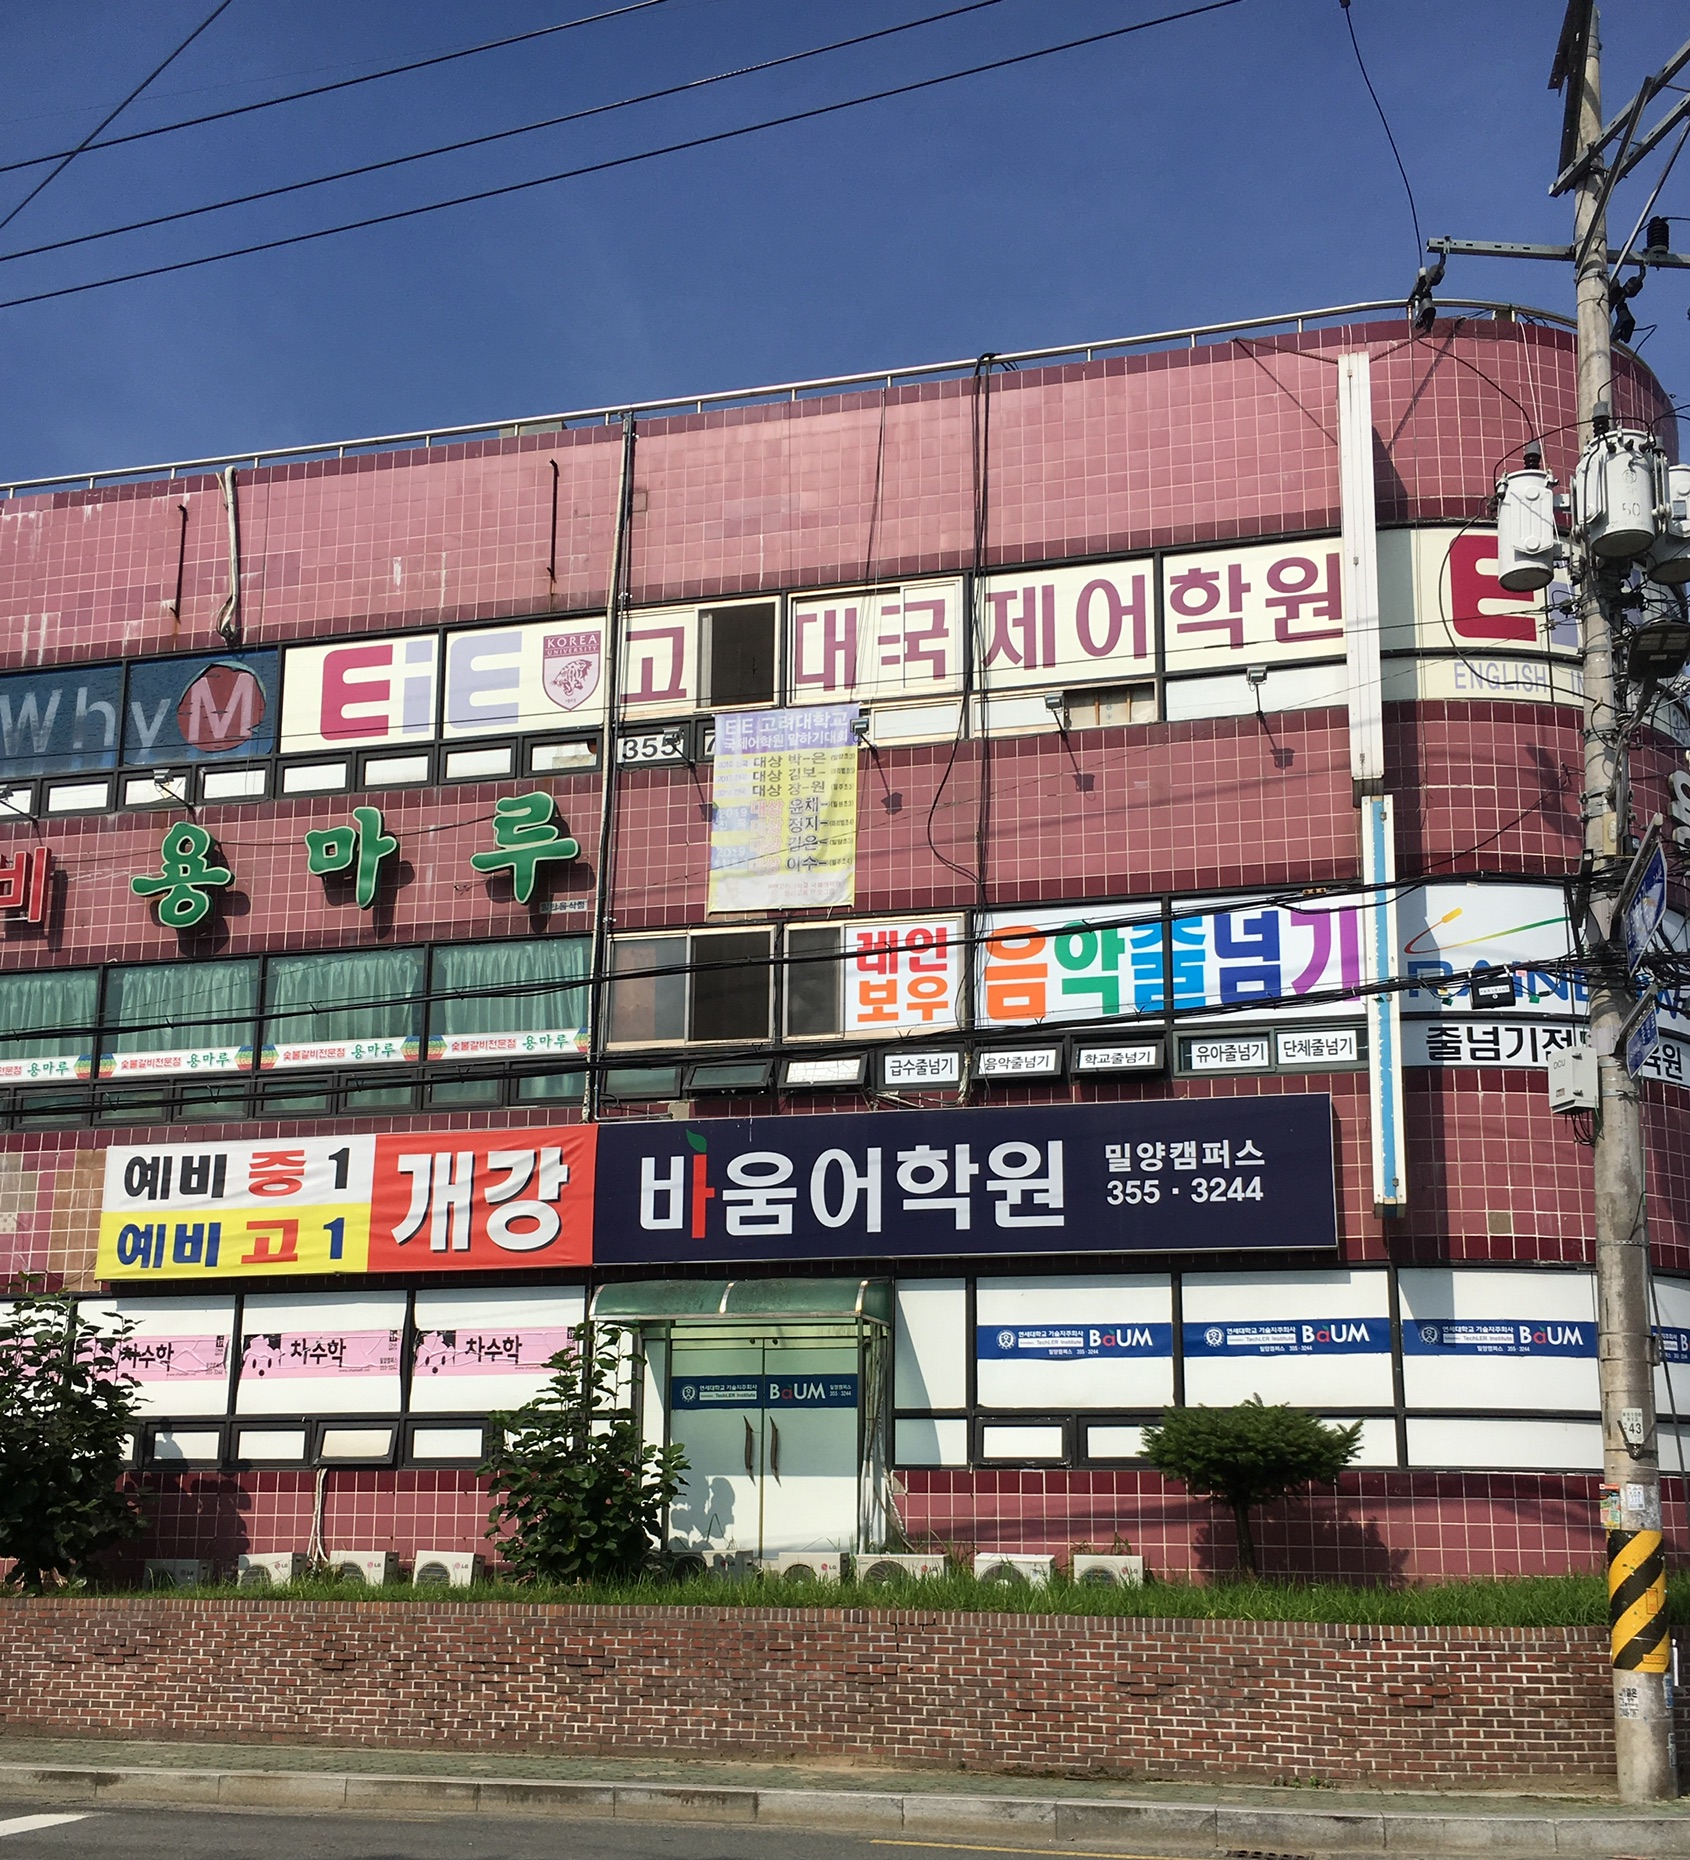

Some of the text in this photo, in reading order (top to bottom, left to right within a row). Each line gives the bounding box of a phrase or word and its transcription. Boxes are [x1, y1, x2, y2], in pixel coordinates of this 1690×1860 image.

[547, 634, 597, 648] KOREA
[547, 645, 597, 656] UNIVERSITY
[1453, 661, 1547, 694] ENGLISH
[760, 711, 848, 734] 고려대학교
[724, 733, 784, 751] 국제어학원
[788, 729, 848, 748] 말하기대회
[753, 755, 783, 769] 대상
[753, 770, 782, 783] 대상
[752, 784, 782, 797] 대상
[720, 807, 748, 819] 2019
[985, 905, 1361, 1022] 음악줄넘기
[857, 975, 949, 1023] 보우
[283, 1043, 396, 1061] 숯불갈비전문점 용마루
[451, 1034, 570, 1052] 숯불갈비전문점 용마루
[1196, 1041, 1265, 1063] 유아줄넘기
[1283, 1036, 1353, 1060] 단체줄넘기
[27, 1061, 70, 1077] 용마루
[121, 1051, 230, 1070] 숯불갈비전문점 용마루
[889, 1058, 953, 1077] 급수줄넘기
[984, 1055, 1049, 1072] 음악줄넘기
[1084, 1050, 1151, 1066] 학교줄넘기
[1105, 1139, 1265, 1173] 밀양캠퍼스
[124, 1153, 228, 1200] 예비
[391, 1147, 570, 1252] 개강
[640, 1140, 1065, 1239] 바움어학원
[117, 1222, 221, 1269] 예비
[121, 1343, 174, 1372] 차수학
[290, 1337, 346, 1367] 차수학
[465, 1334, 522, 1365] 차수학
[1629, 1423, 1641, 1434] 43
